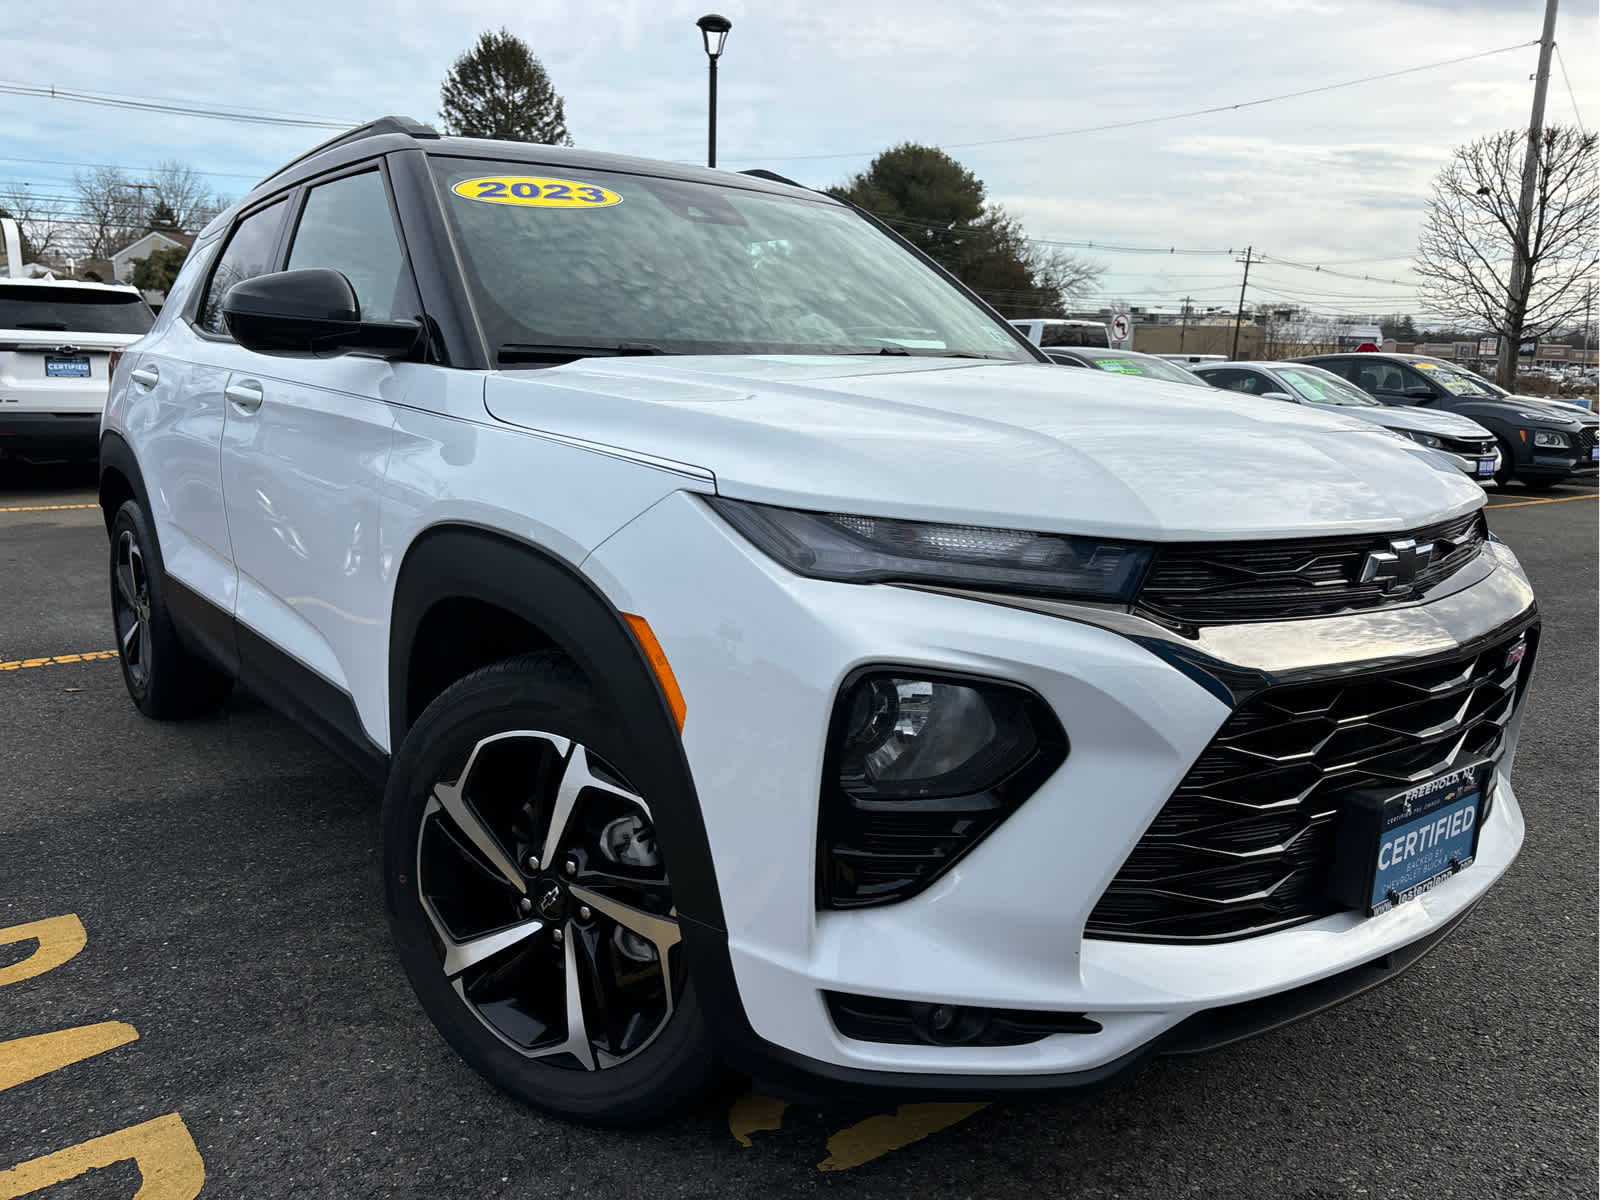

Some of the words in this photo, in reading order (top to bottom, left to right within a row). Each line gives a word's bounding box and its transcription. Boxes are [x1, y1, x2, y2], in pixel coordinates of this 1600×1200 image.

[476, 181, 606, 204] 2023
[47, 362, 89, 370] CERTIFIED
[1377, 805, 1476, 871] CERTIFIED
[1406, 853, 1433, 873] BACKED
[1423, 859, 1444, 875] BUICK
